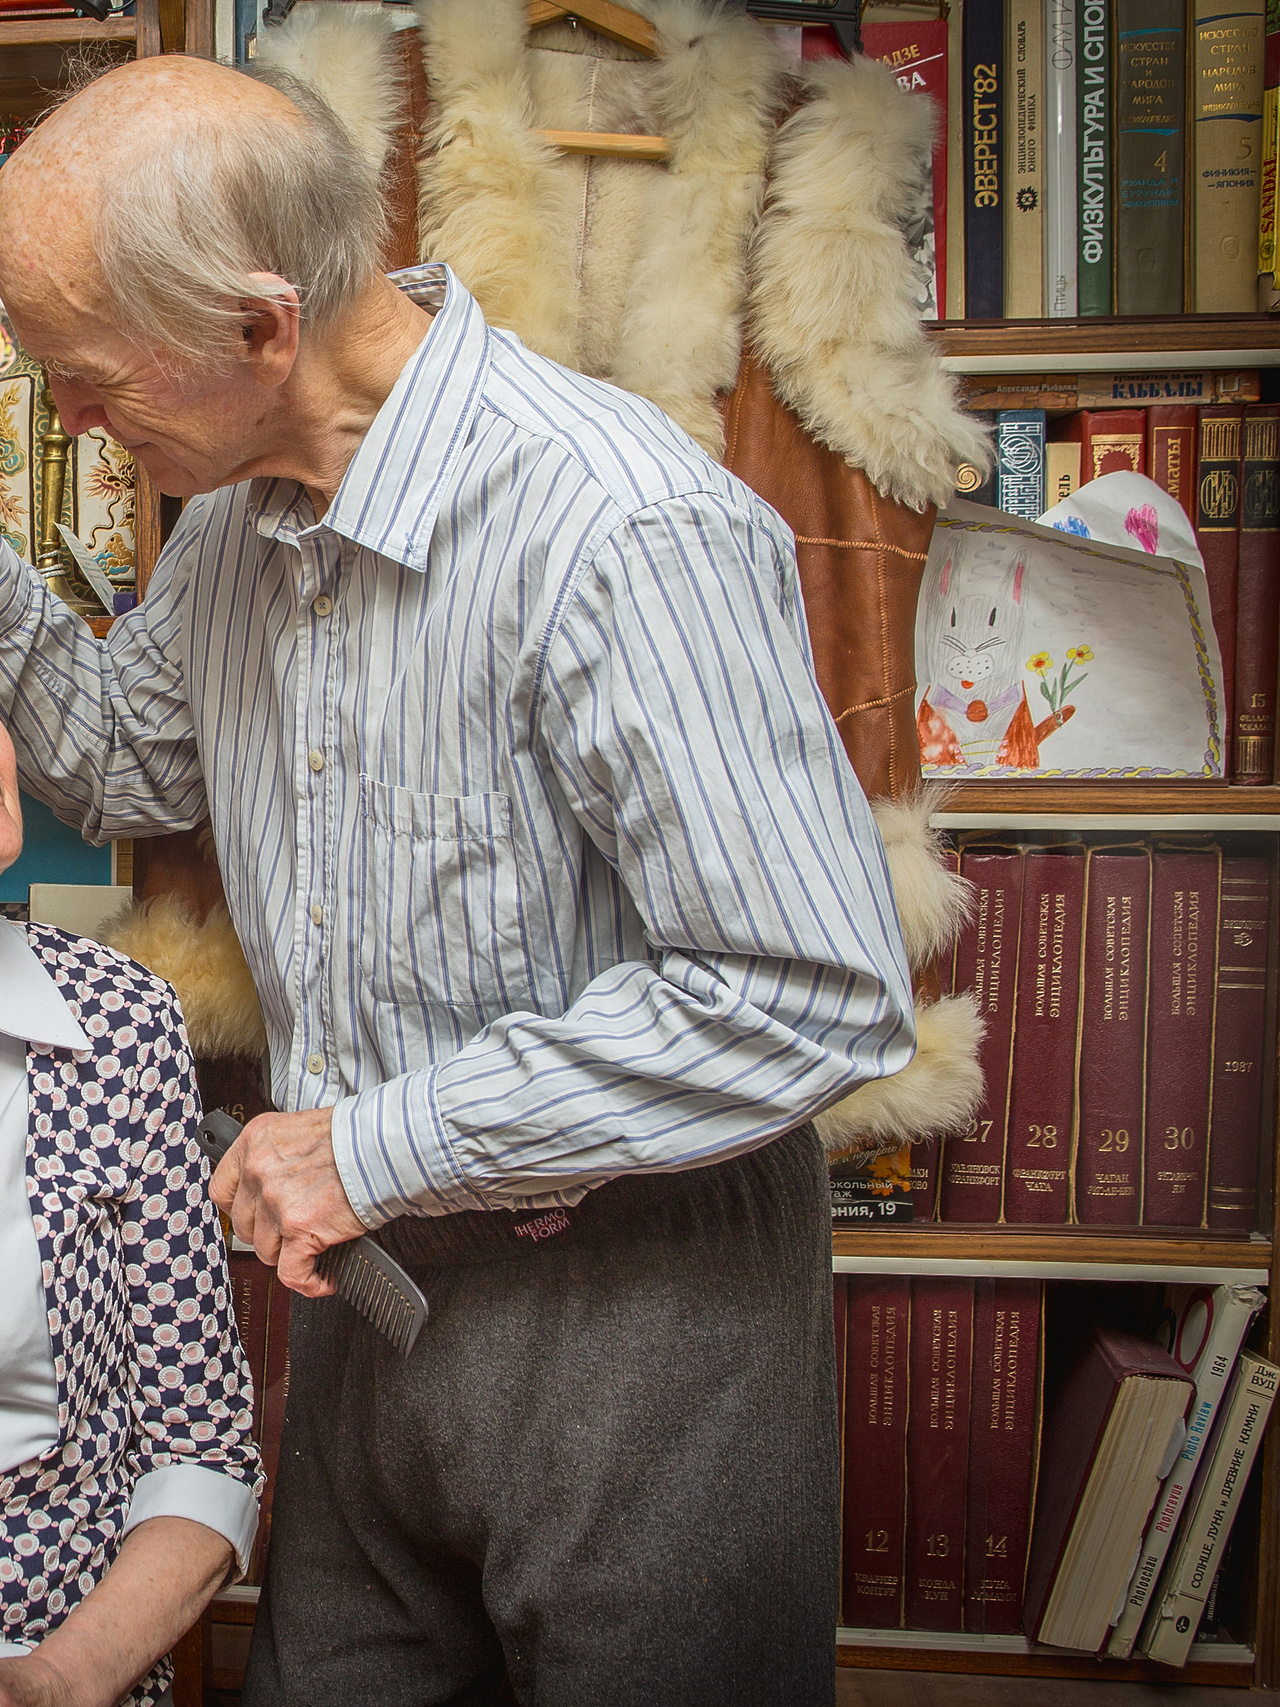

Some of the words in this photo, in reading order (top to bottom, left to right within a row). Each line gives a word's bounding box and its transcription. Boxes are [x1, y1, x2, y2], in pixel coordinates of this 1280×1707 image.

[1018, 20, 1026, 62] СЛОВАРЬ
[1200, 28, 1259, 41] ИСКУССТВО
[1210, 44, 1250, 55] СТРАН
[1084, 66, 1104, 85] И
[1130, 58, 1168, 67] СТРАН
[1202, 66, 1256, 78] НАРОДОВ
[1132, 96, 1162, 104] МИРА
[1213, 83, 1246, 92] МИРА
[1018, 68, 1026, 174] ЭНЦИКЛОПЕДИЧЕСКИЙ
[1028, 94, 1036, 132] ФИЗИКА
[974, 64, 998, 208] ЭВЕРЕСТ'82
[1236, 137, 1252, 160] 5
[1028, 139, 1036, 172] ЮНОГО
[1154, 150, 1166, 172] 4
[1083, 88, 1104, 264] ФИЗКУЛЬТУРА
[1122, 178, 1166, 188] РУАНДА
[1054, 274, 1066, 312] Птицы
[997, 384, 1039, 394] Александр
[1042, 383, 1076, 392] Рыбалка
[1112, 382, 1203, 400] КАББАЛЫ
[1038, 893, 1050, 958] СОВЕТСКАЯ
[1106, 896, 1116, 962] СОВЕТСКАЯ
[989, 889, 1004, 1012] ЭНЦИКЛОПЕДИЯ
[1050, 894, 1066, 1018] ЭНЦИКЛОПЕДИЯ
[1118, 896, 1132, 1020] ЭНЦИКЛОПЕДИЯ
[1186, 890, 1199, 1016] ЭНЦИКЛОПЕДИЯ
[1035, 963, 1046, 1016] БОЛЬШАЯ
[1104, 967, 1114, 1020] БОЛЬШАЯ
[1224, 1061, 1253, 1072] 1987
[964, 1120, 994, 1143] 27
[1026, 1124, 1058, 1148] 28
[1098, 1129, 1130, 1152] 29
[1164, 1126, 1195, 1150] 30
[530, 1217, 571, 1242] FORM
[871, 1306, 880, 1368] СОВЕТСКАЯ
[932, 1308, 942, 1372] СОВЕТСКАЯ
[994, 1311, 1006, 1372] СОВЕТСКАЯ
[883, 1306, 896, 1426] ЭНЦИКЛОПЕДИЯ
[945, 1310, 957, 1430] ЭНЦИКЛОПЕДИЯ
[1004, 1311, 1020, 1430] ЭНЦИКЛОПЕДИЯ
[1210, 1355, 1228, 1378] 1964
[1251, 1376, 1276, 1392] ВУД
[869, 1374, 878, 1424] БОЛЬШАЯ
[930, 1377, 940, 1428] БОЛЬШАЯ
[990, 1378, 1001, 1430] БОЛЬШАЯ
[1181, 1432, 1200, 1461] Photo
[1193, 1400, 1214, 1432] Review
[1155, 1482, 1184, 1534] Photorevue
[1190, 1541, 1215, 1589] СОЛНЦЕ,
[1206, 1508, 1226, 1542] ЛУНА
[1226, 1448, 1246, 1500] ДРЕВНИЕ
[1238, 1402, 1260, 1445] КАМНИ
[866, 1530, 889, 1552] 12
[926, 1534, 950, 1557] 13
[986, 1534, 1008, 1558] 14
[1130, 1556, 1158, 1607] Photoschau
